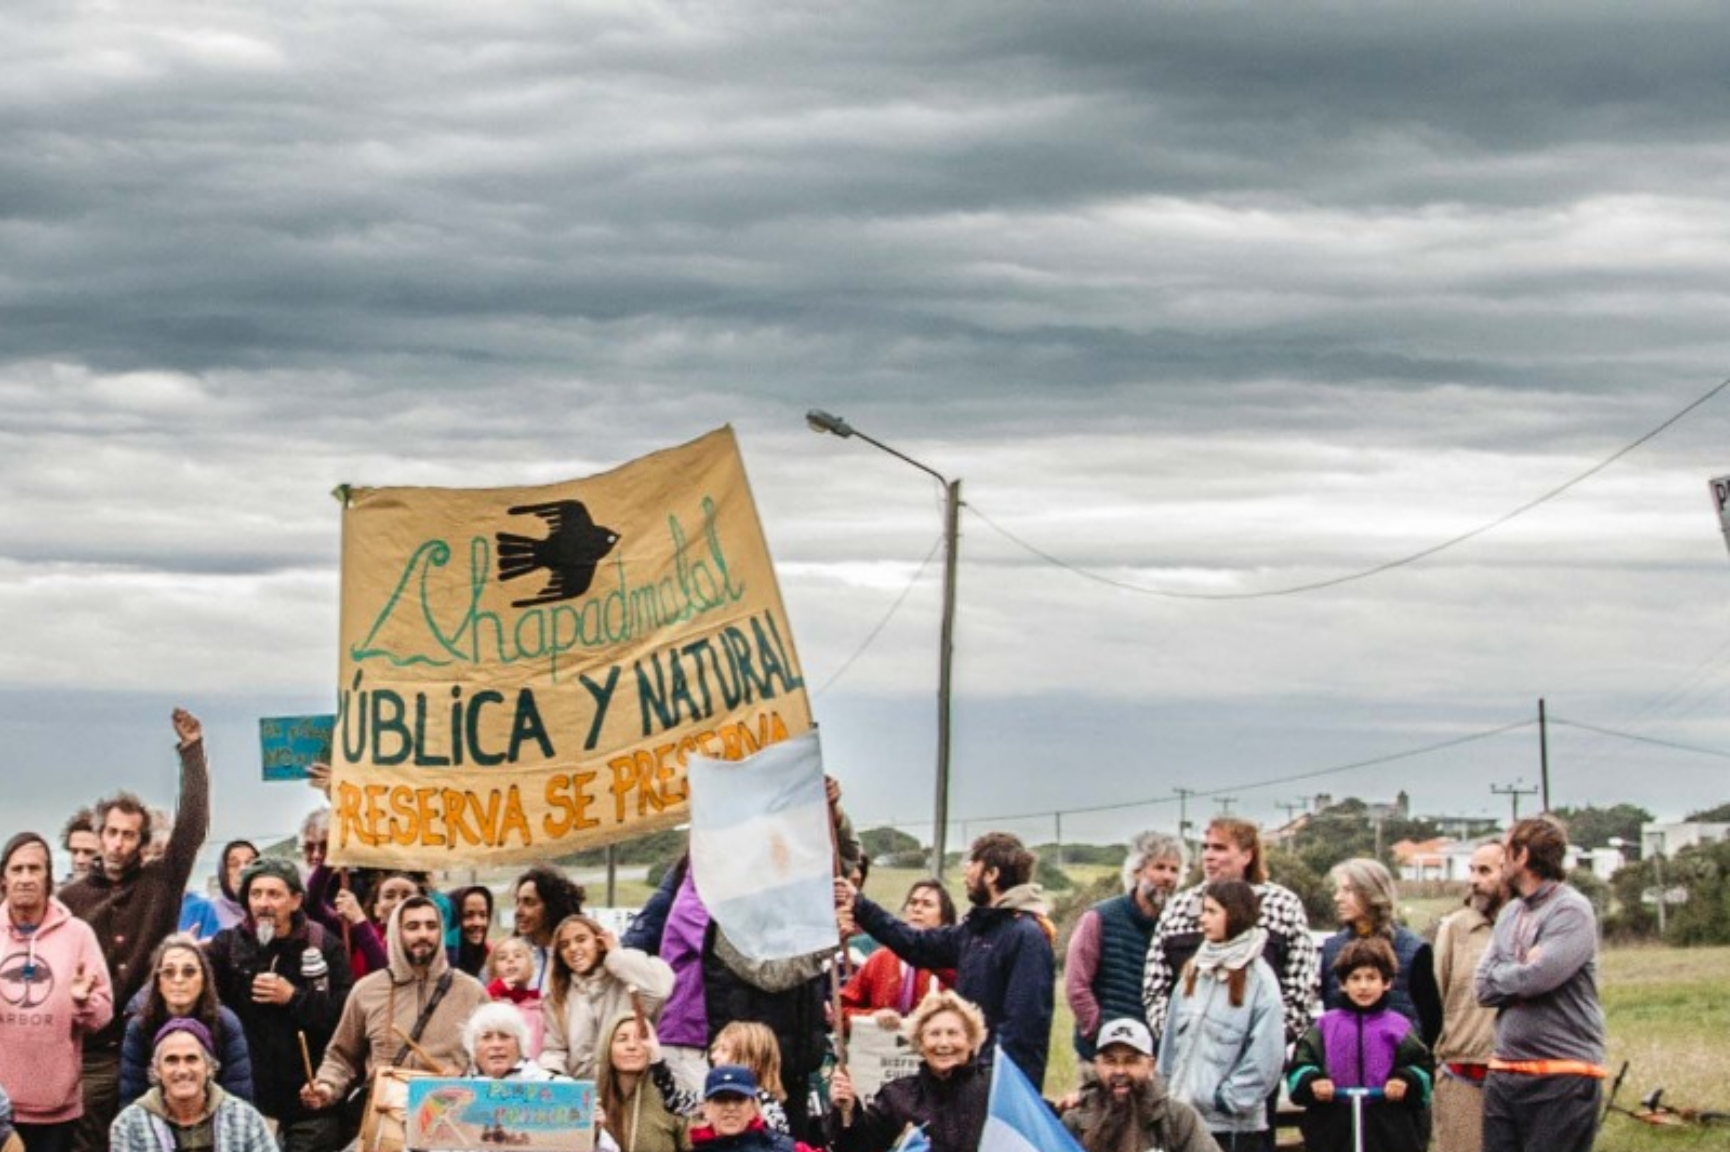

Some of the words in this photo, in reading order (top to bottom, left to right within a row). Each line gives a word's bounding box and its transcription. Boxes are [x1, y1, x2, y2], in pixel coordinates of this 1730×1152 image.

[579, 665, 622, 751] Y
[635, 609, 805, 737] NATURAL
[336, 780, 533, 850] RESERVA
[543, 770, 601, 840] SE
